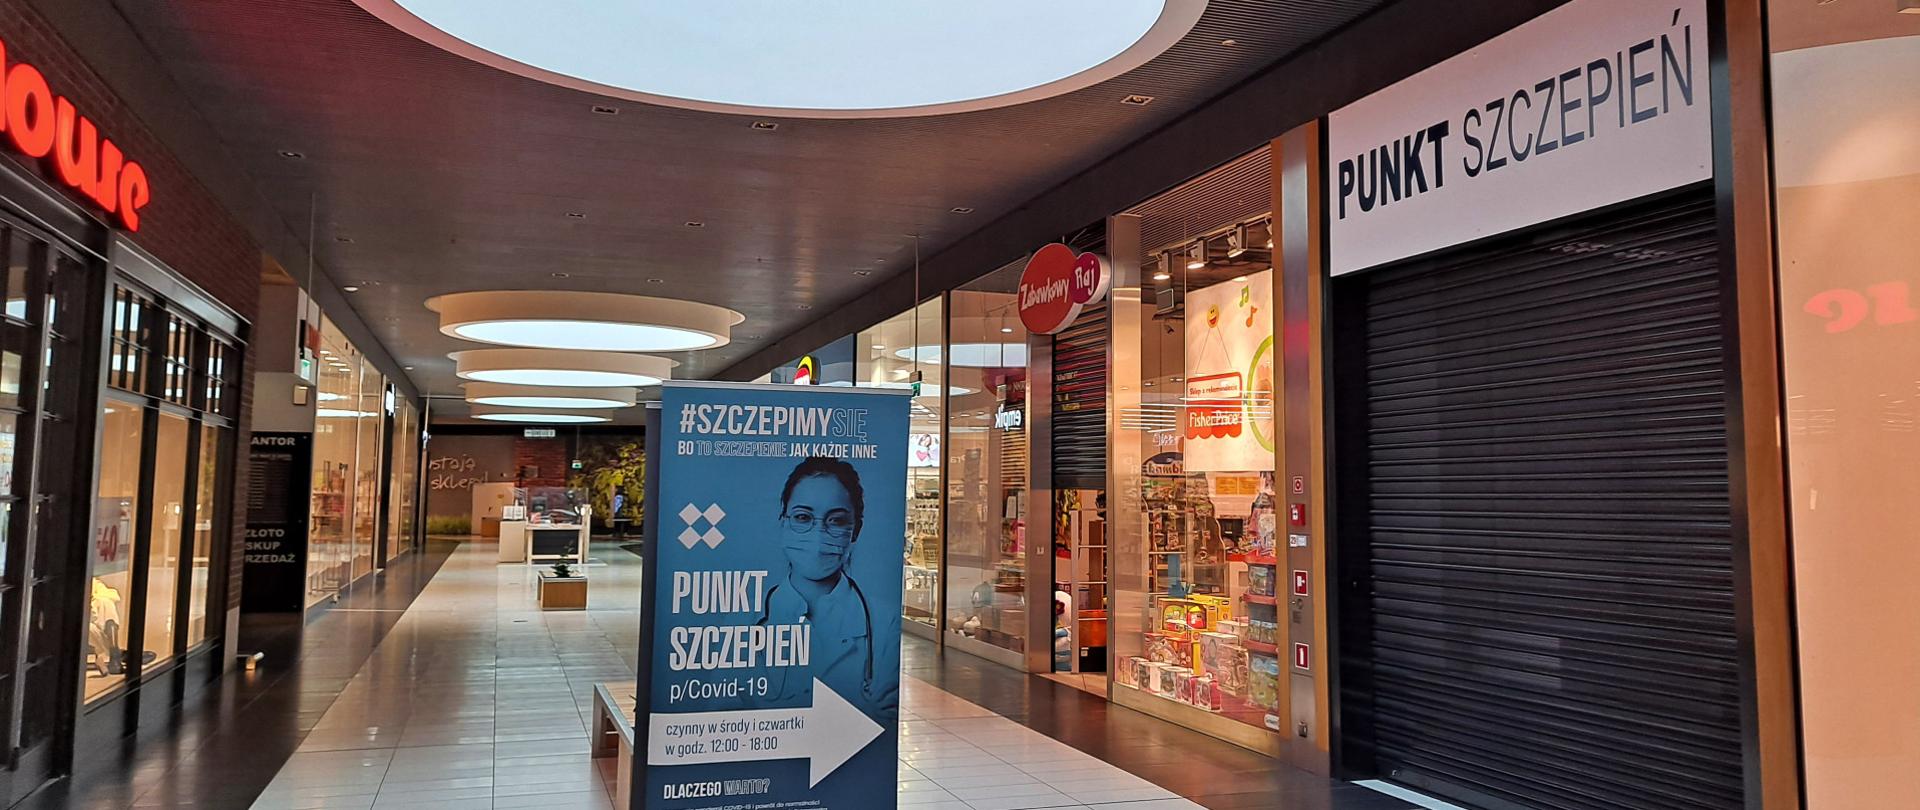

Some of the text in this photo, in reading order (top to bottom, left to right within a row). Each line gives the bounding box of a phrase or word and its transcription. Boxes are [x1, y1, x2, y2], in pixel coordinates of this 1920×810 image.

[1338, 8, 1694, 219] PUNKT SZCZEPIEŃ
[1020, 260, 1095, 311] Zabawkowy Raj
[680, 403, 868, 442] #SZCZEPIMYSIĘ
[678, 440, 878, 459] BO TO SZCZEPIENIE JAK KAŻDE INNE
[245, 541, 281, 551] SKUP
[671, 570, 768, 615] PUNKT
[669, 616, 811, 671] SZCZEPIEŃ
[670, 677, 768, 704] p/Covid-19
[666, 715, 804, 739] czynny w środy i czwartki
[665, 743, 675, 755] w
[677, 740, 707, 758] godz.
[711, 739, 739, 753] 12:00
[750, 736, 778, 751] 18:00
[663, 778, 771, 800] DLACZEGO WARTO?
